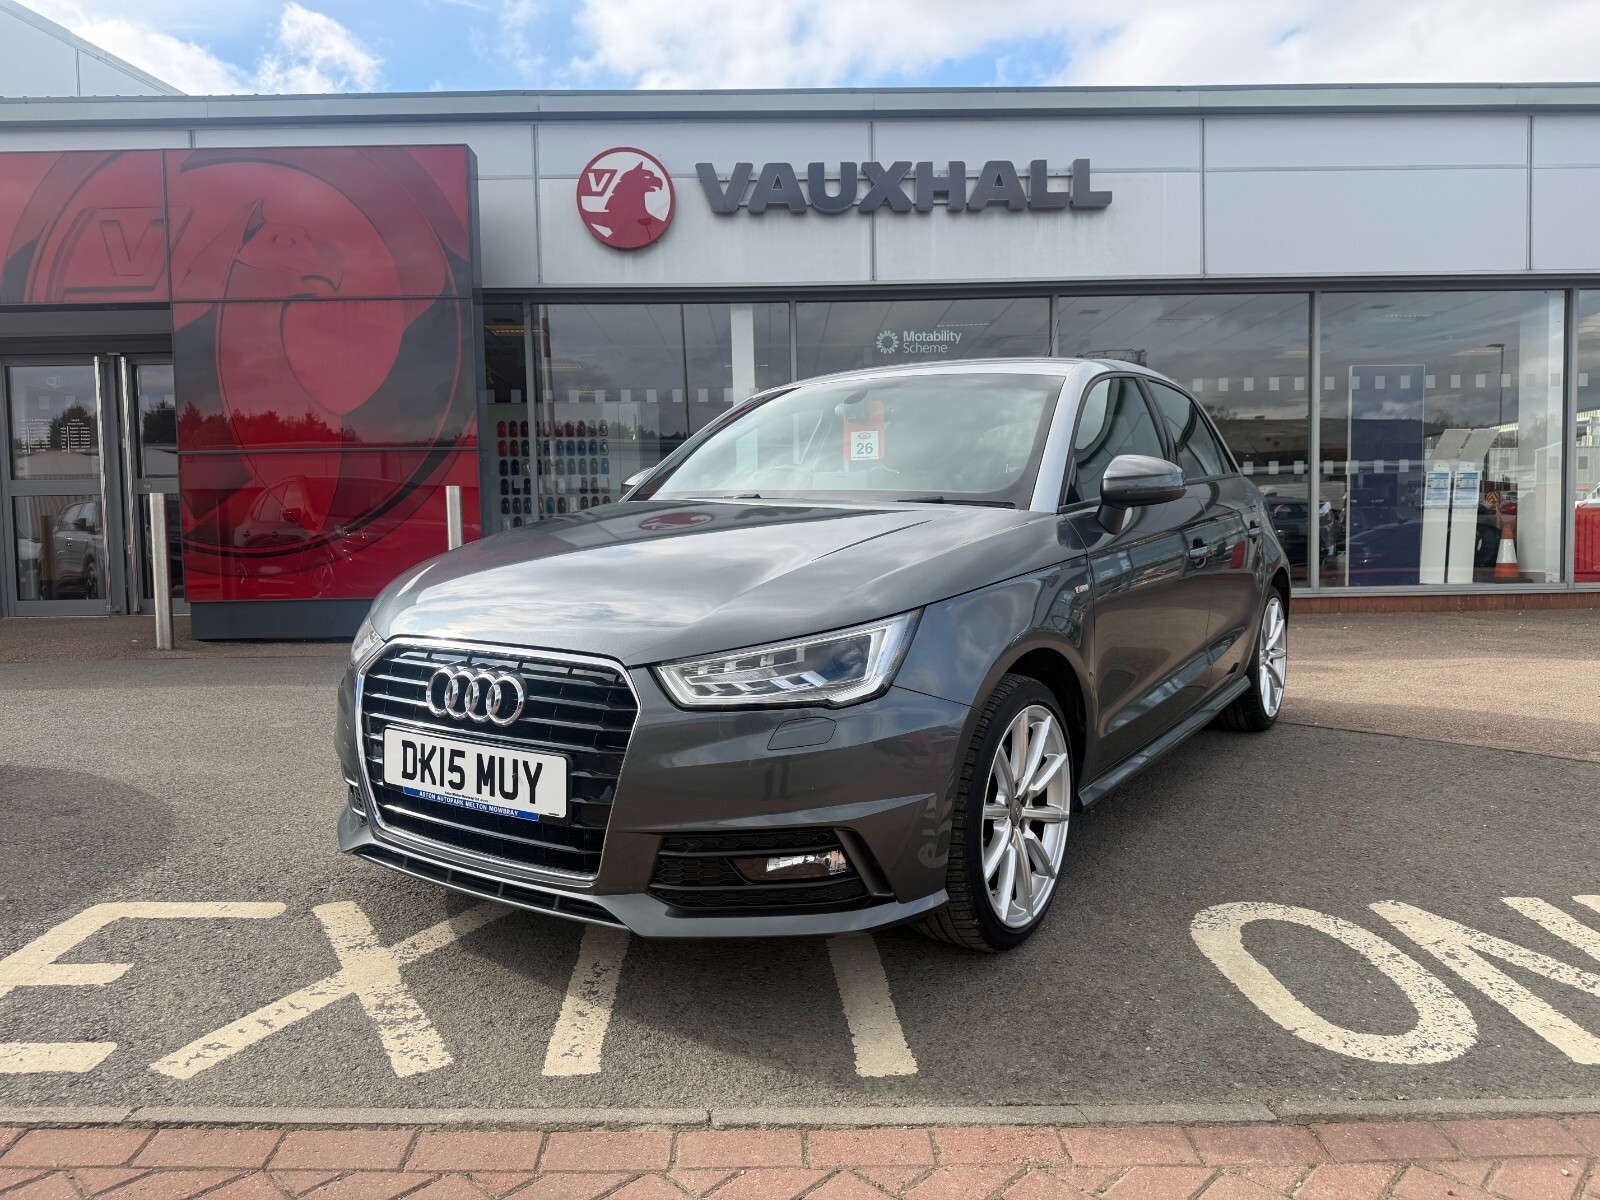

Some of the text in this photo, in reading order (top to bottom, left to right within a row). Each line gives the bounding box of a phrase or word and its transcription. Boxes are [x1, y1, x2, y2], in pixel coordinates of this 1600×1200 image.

[695, 158, 1113, 214] VAUXHALL
[903, 330, 961, 344] Motability
[903, 343, 948, 353] Scheme
[856, 442, 874, 455] 26
[402, 739, 543, 804] DK15 MUY
[419, 791, 436, 800] ASTON
[437, 794, 464, 806] AUTOPARK
[465, 801, 487, 811] MELTON
[488, 805, 519, 817] MOWBRAY
